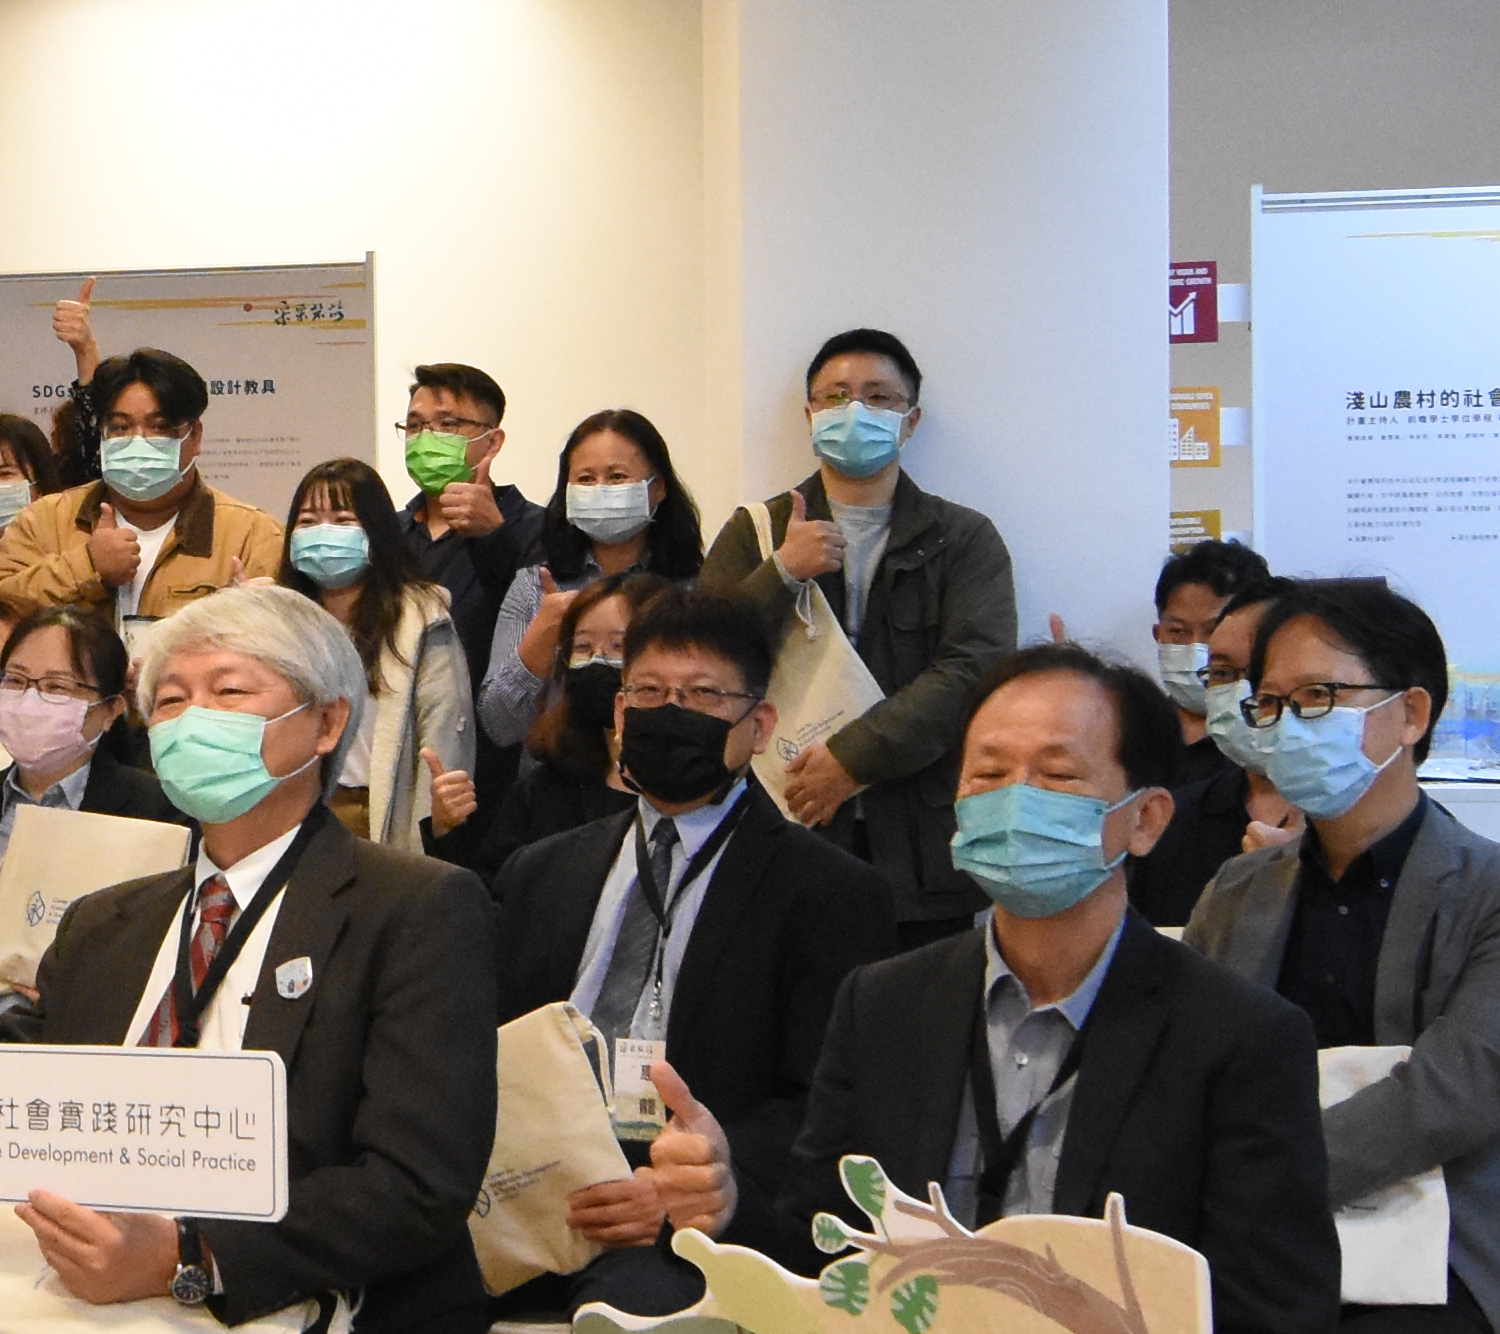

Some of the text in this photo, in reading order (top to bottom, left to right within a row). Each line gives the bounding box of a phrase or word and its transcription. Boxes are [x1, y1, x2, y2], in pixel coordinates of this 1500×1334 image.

[8, 1141, 114, 1166] Development
[119, 1147, 131, 1165] &
[137, 1148, 186, 1168] Social
[192, 1150, 257, 1171] Practice
